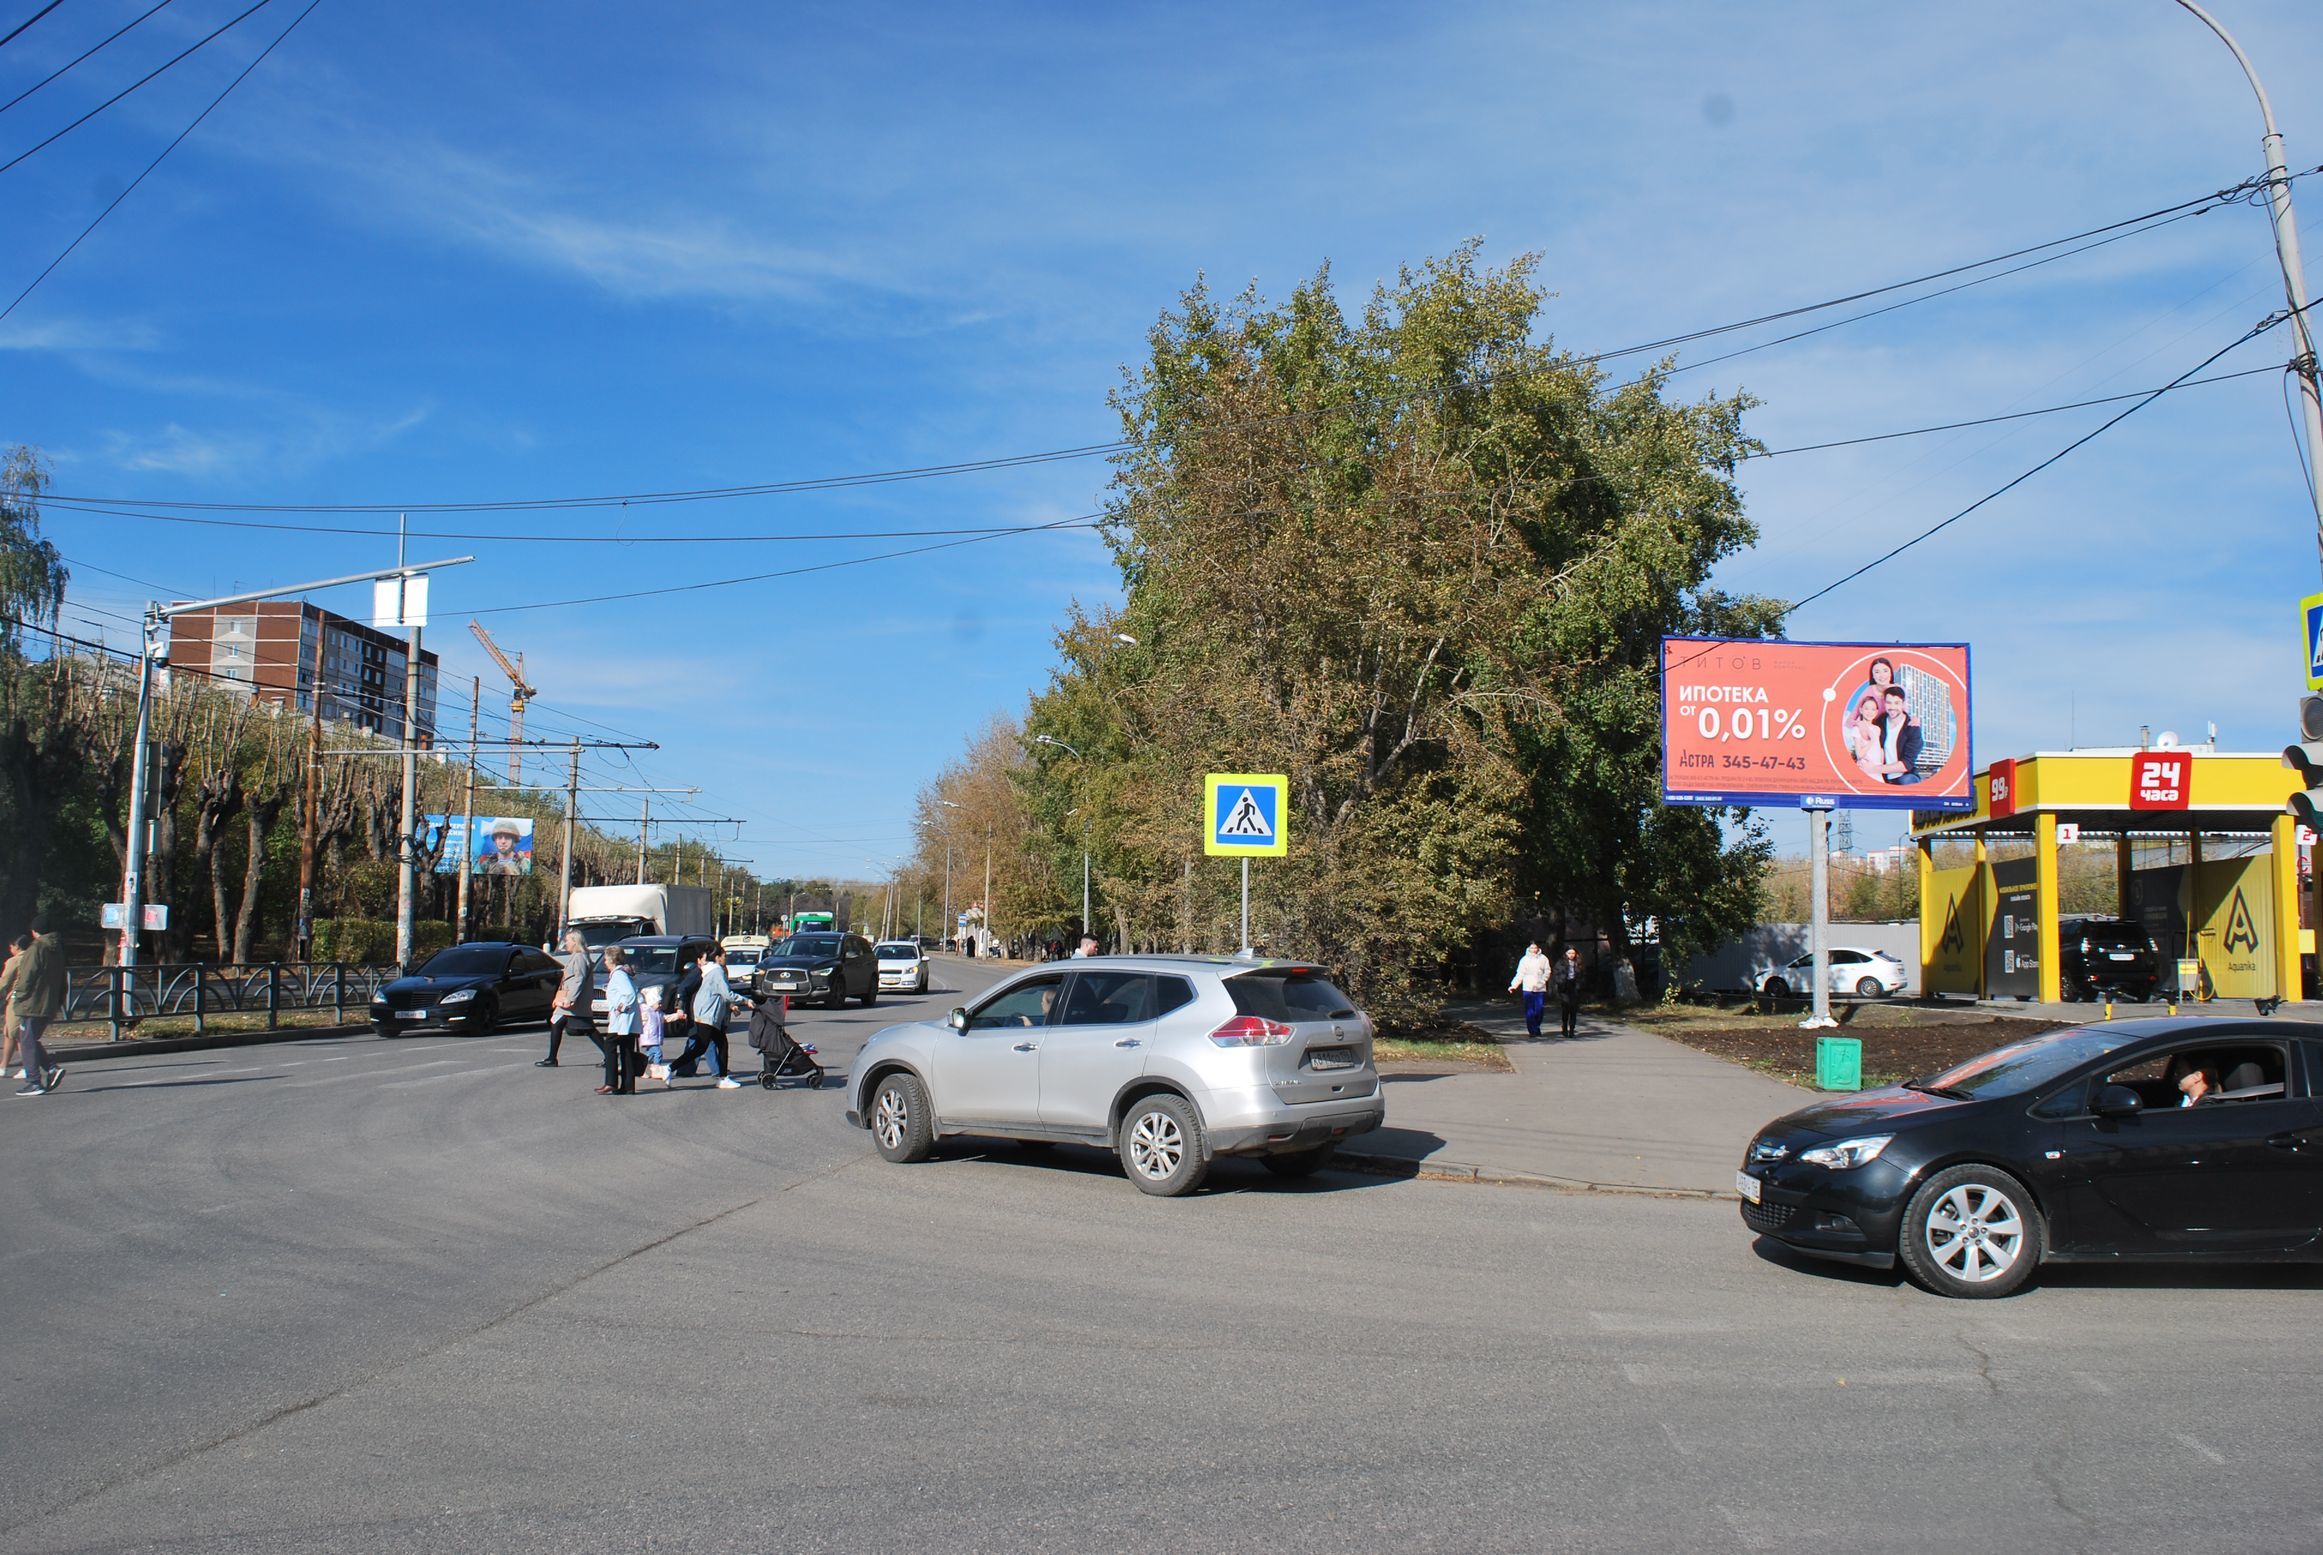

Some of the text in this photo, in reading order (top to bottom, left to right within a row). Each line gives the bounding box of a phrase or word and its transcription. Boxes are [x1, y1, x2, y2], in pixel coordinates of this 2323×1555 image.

[1679, 685, 1768, 703] ИПОТЕКА
[1698, 706, 1806, 742] 0,01%
[1723, 755, 1806, 769] 345-47-43
[2141, 762, 2181, 787] 24
[2140, 789, 2179, 801] часа
[2063, 828, 2071, 839] 1
